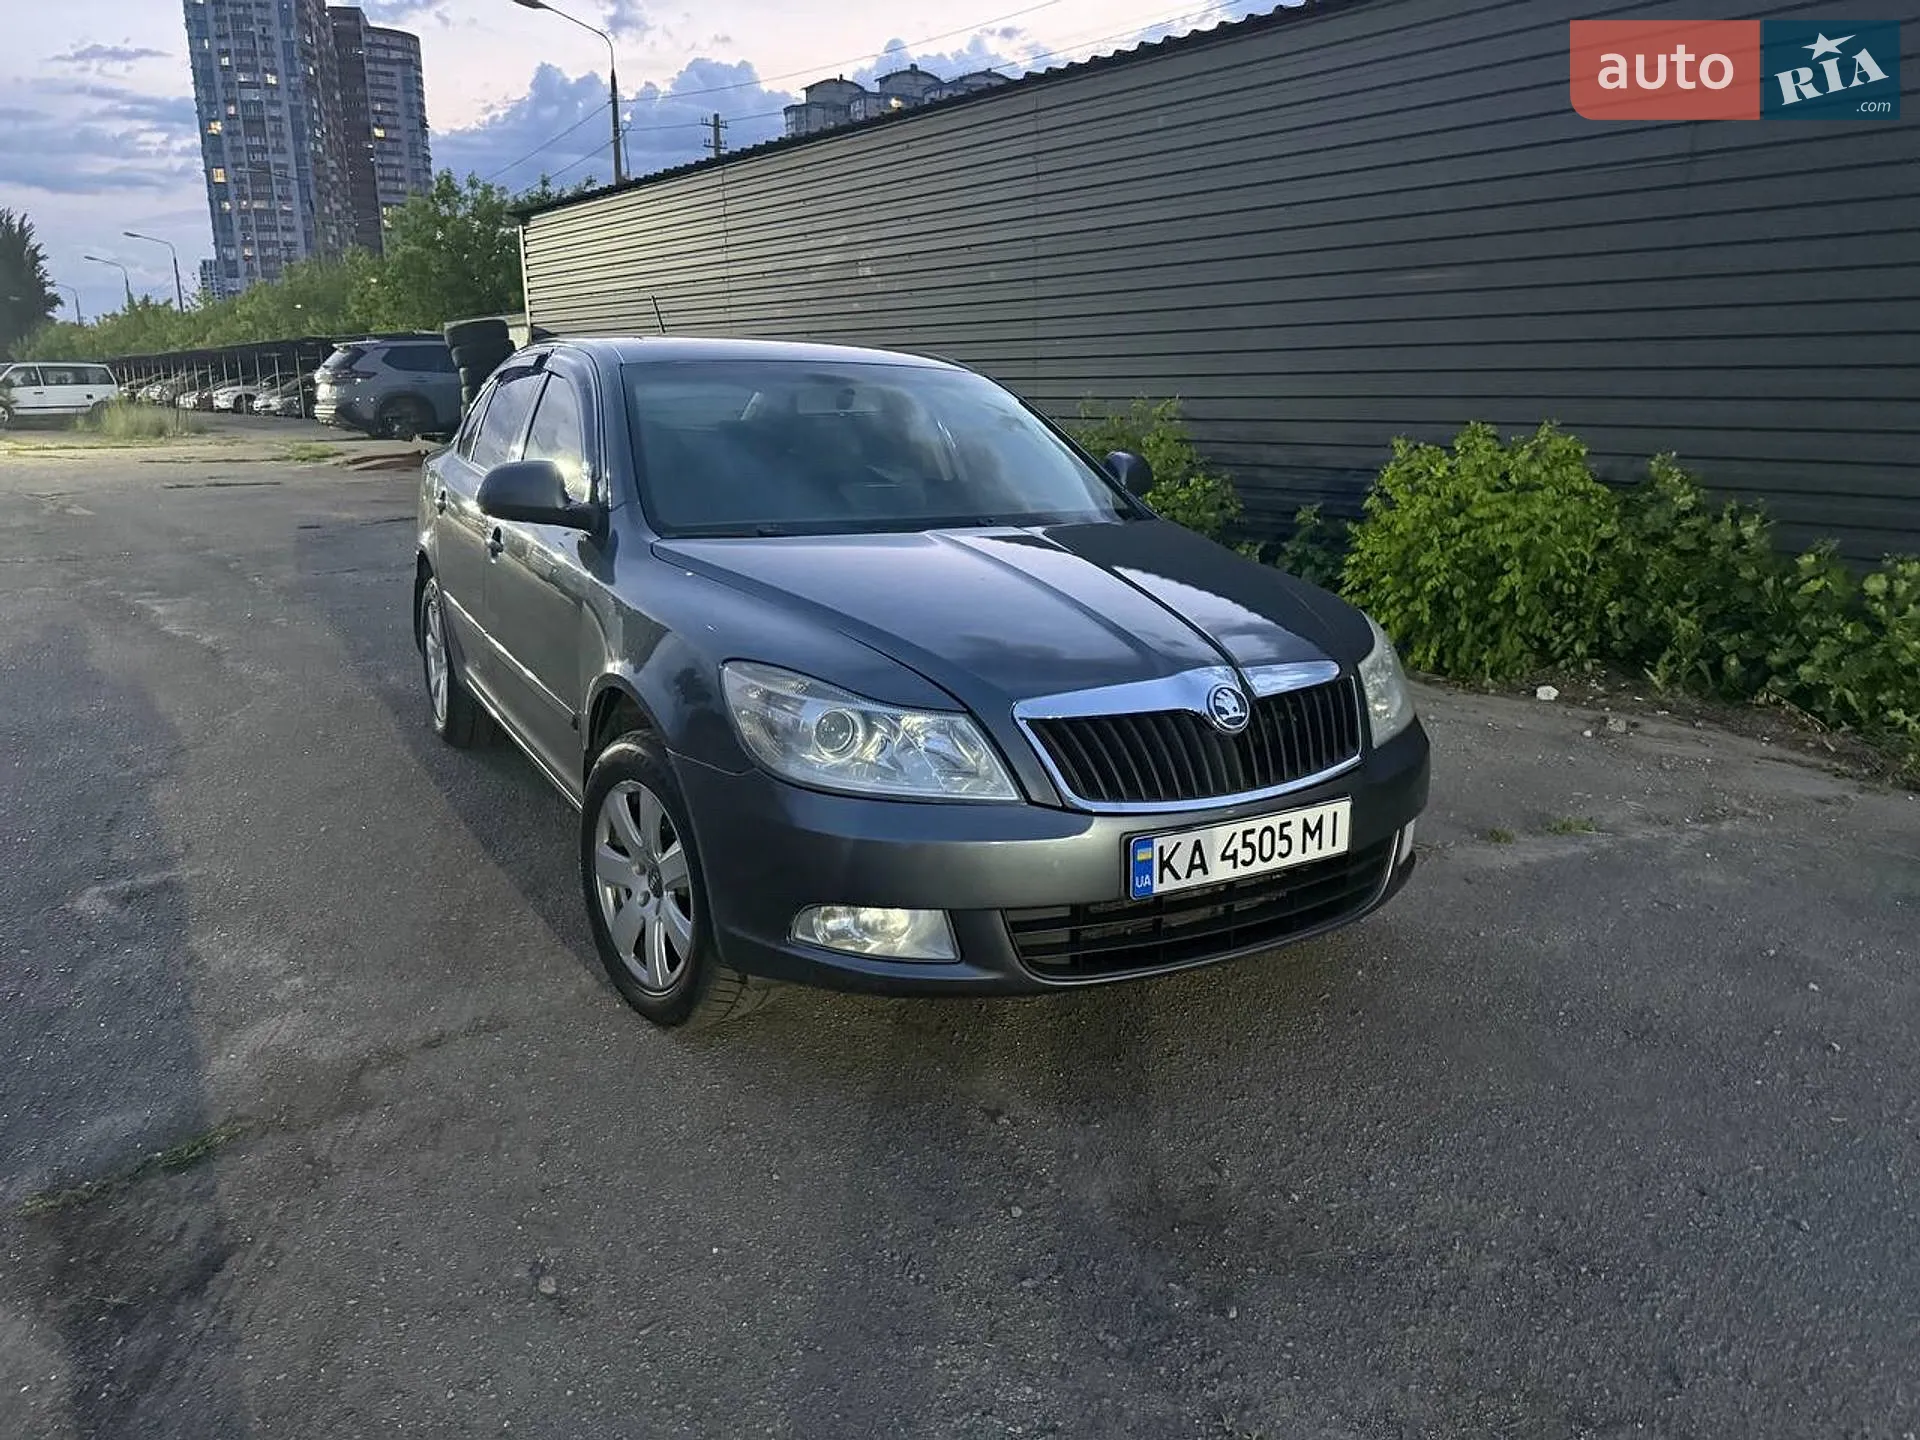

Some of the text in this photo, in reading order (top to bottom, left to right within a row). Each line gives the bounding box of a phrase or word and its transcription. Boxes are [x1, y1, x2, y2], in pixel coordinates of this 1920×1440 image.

[1158, 811, 1338, 885] KA 4505 MI
[1135, 873, 1152, 888] UA
